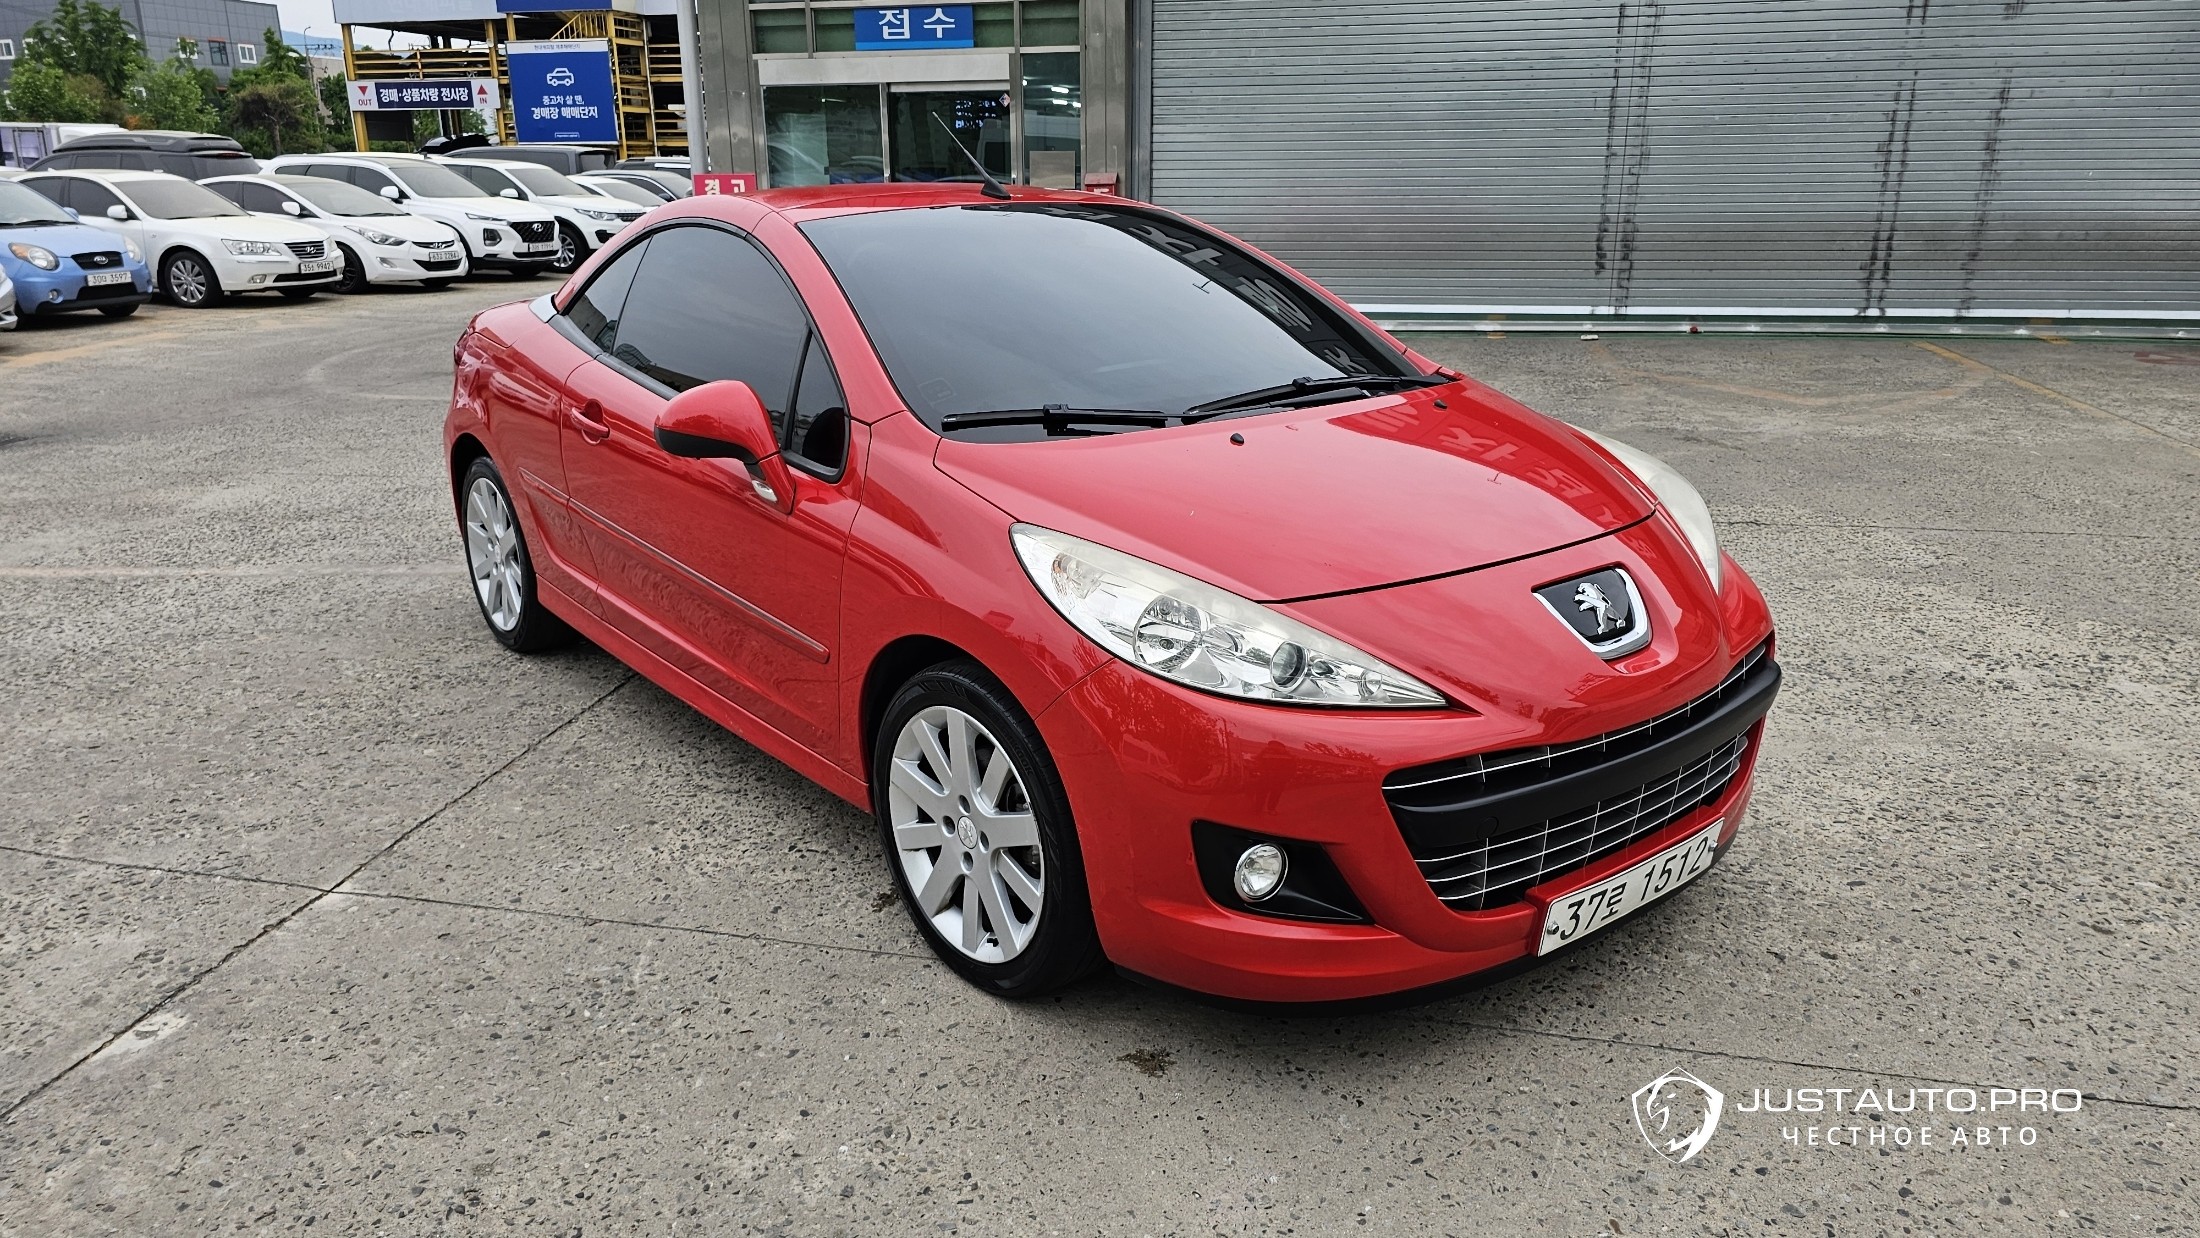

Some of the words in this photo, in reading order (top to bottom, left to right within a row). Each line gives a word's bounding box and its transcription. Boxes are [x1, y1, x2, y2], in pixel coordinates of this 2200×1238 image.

[878, 7, 956, 40] 접수
[440, 87, 469, 101] 전시장
[479, 97, 488, 105] IN
[542, 95, 564, 106] 중고차
[565, 95, 573, 105] 살
[358, 98, 372, 106] OUT
[531, 106, 560, 120] 경매장
[561, 106, 598, 119] 매매단지
[1559, 881, 1628, 941] 37로
[1640, 835, 1710, 902] 1512
